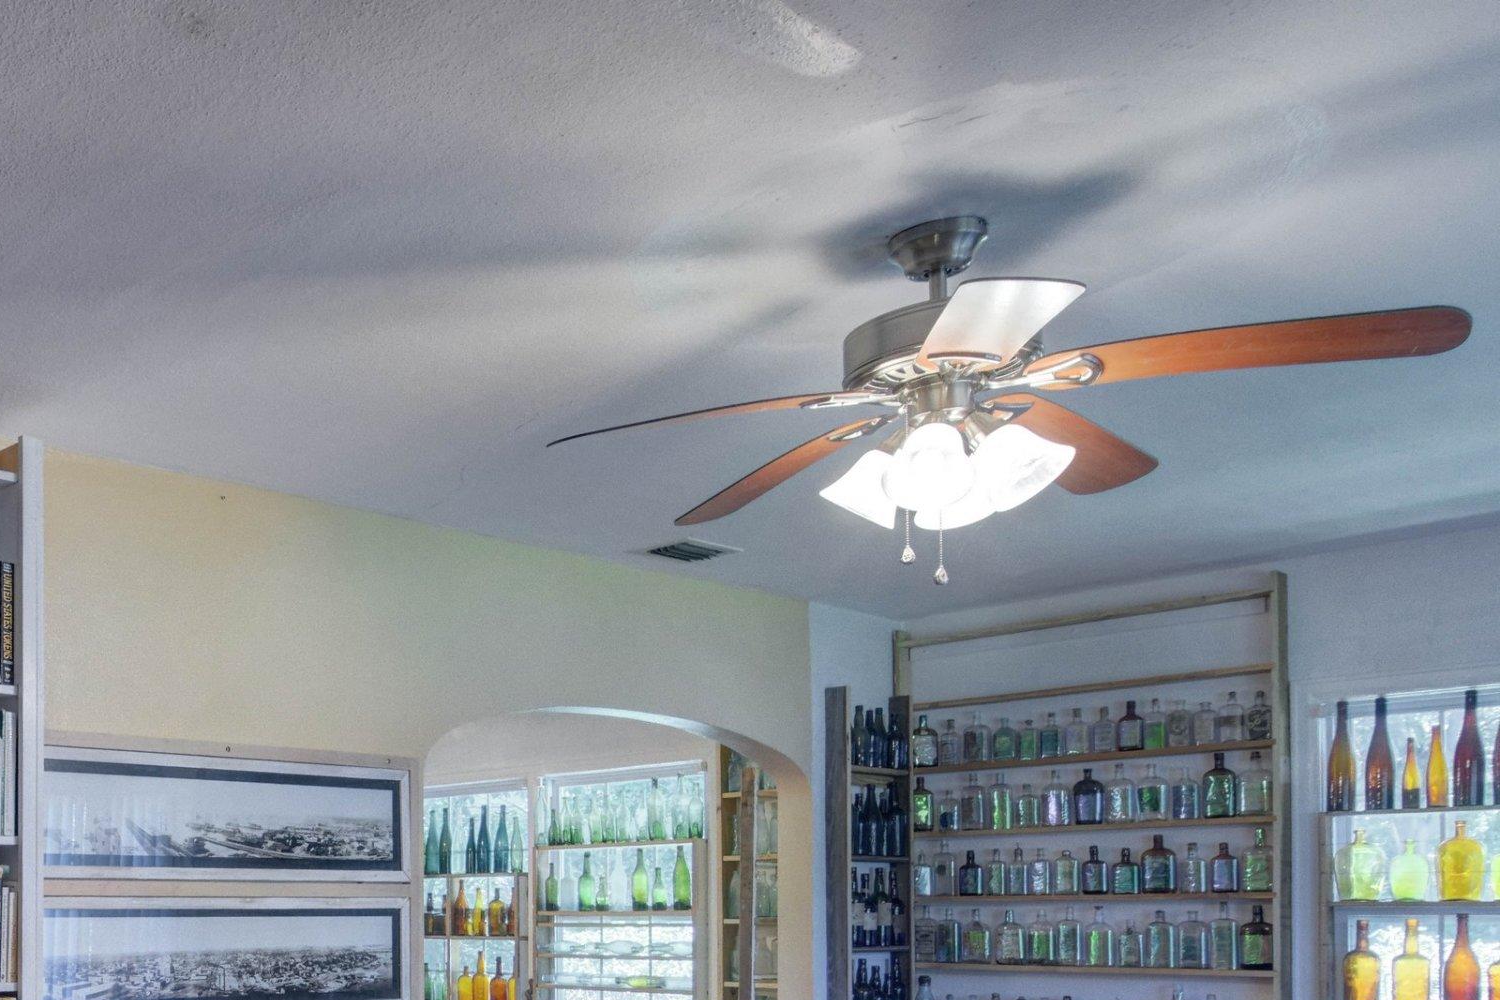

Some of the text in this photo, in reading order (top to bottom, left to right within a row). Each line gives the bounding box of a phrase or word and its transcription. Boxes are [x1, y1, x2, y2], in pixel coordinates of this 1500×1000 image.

[3, 574, 13, 659] UNITED STATES TOKENS
